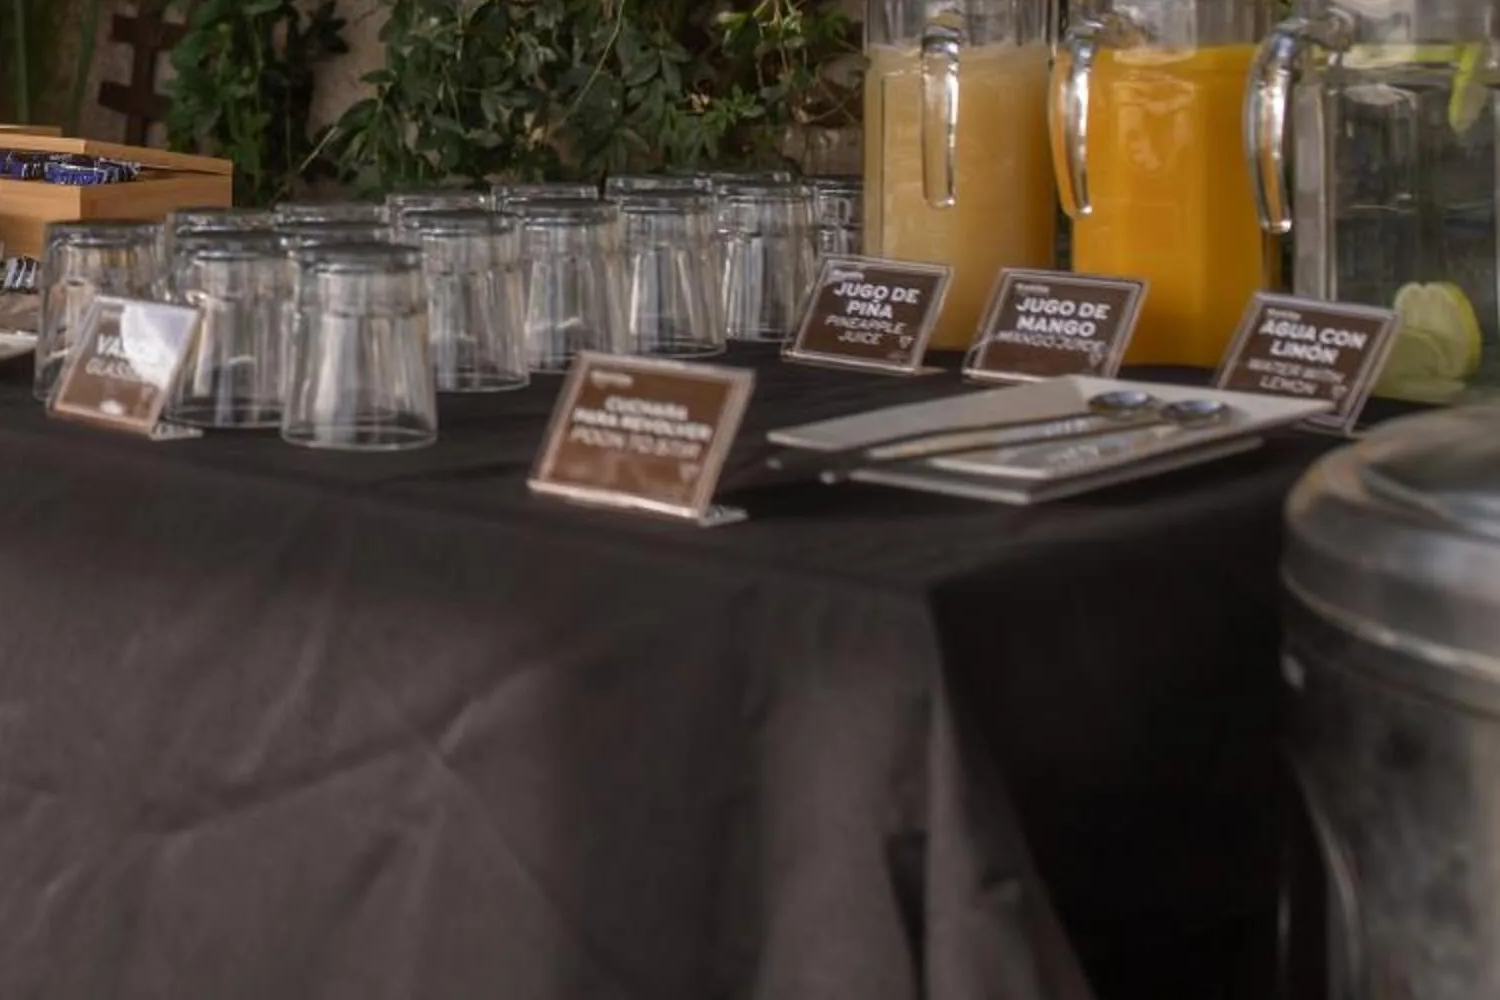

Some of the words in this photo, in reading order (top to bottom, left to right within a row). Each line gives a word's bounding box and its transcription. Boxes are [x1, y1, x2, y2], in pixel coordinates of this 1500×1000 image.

[833, 282, 889, 300] JUGO
[891, 287, 921, 304] DE
[846, 299, 893, 319] PIÑA
[1016, 297, 1076, 317] JUGO
[1078, 302, 1111, 319] DE
[1016, 315, 1096, 337] MANGO
[1259, 319, 1317, 341] AGUA
[1319, 328, 1368, 350] CON
